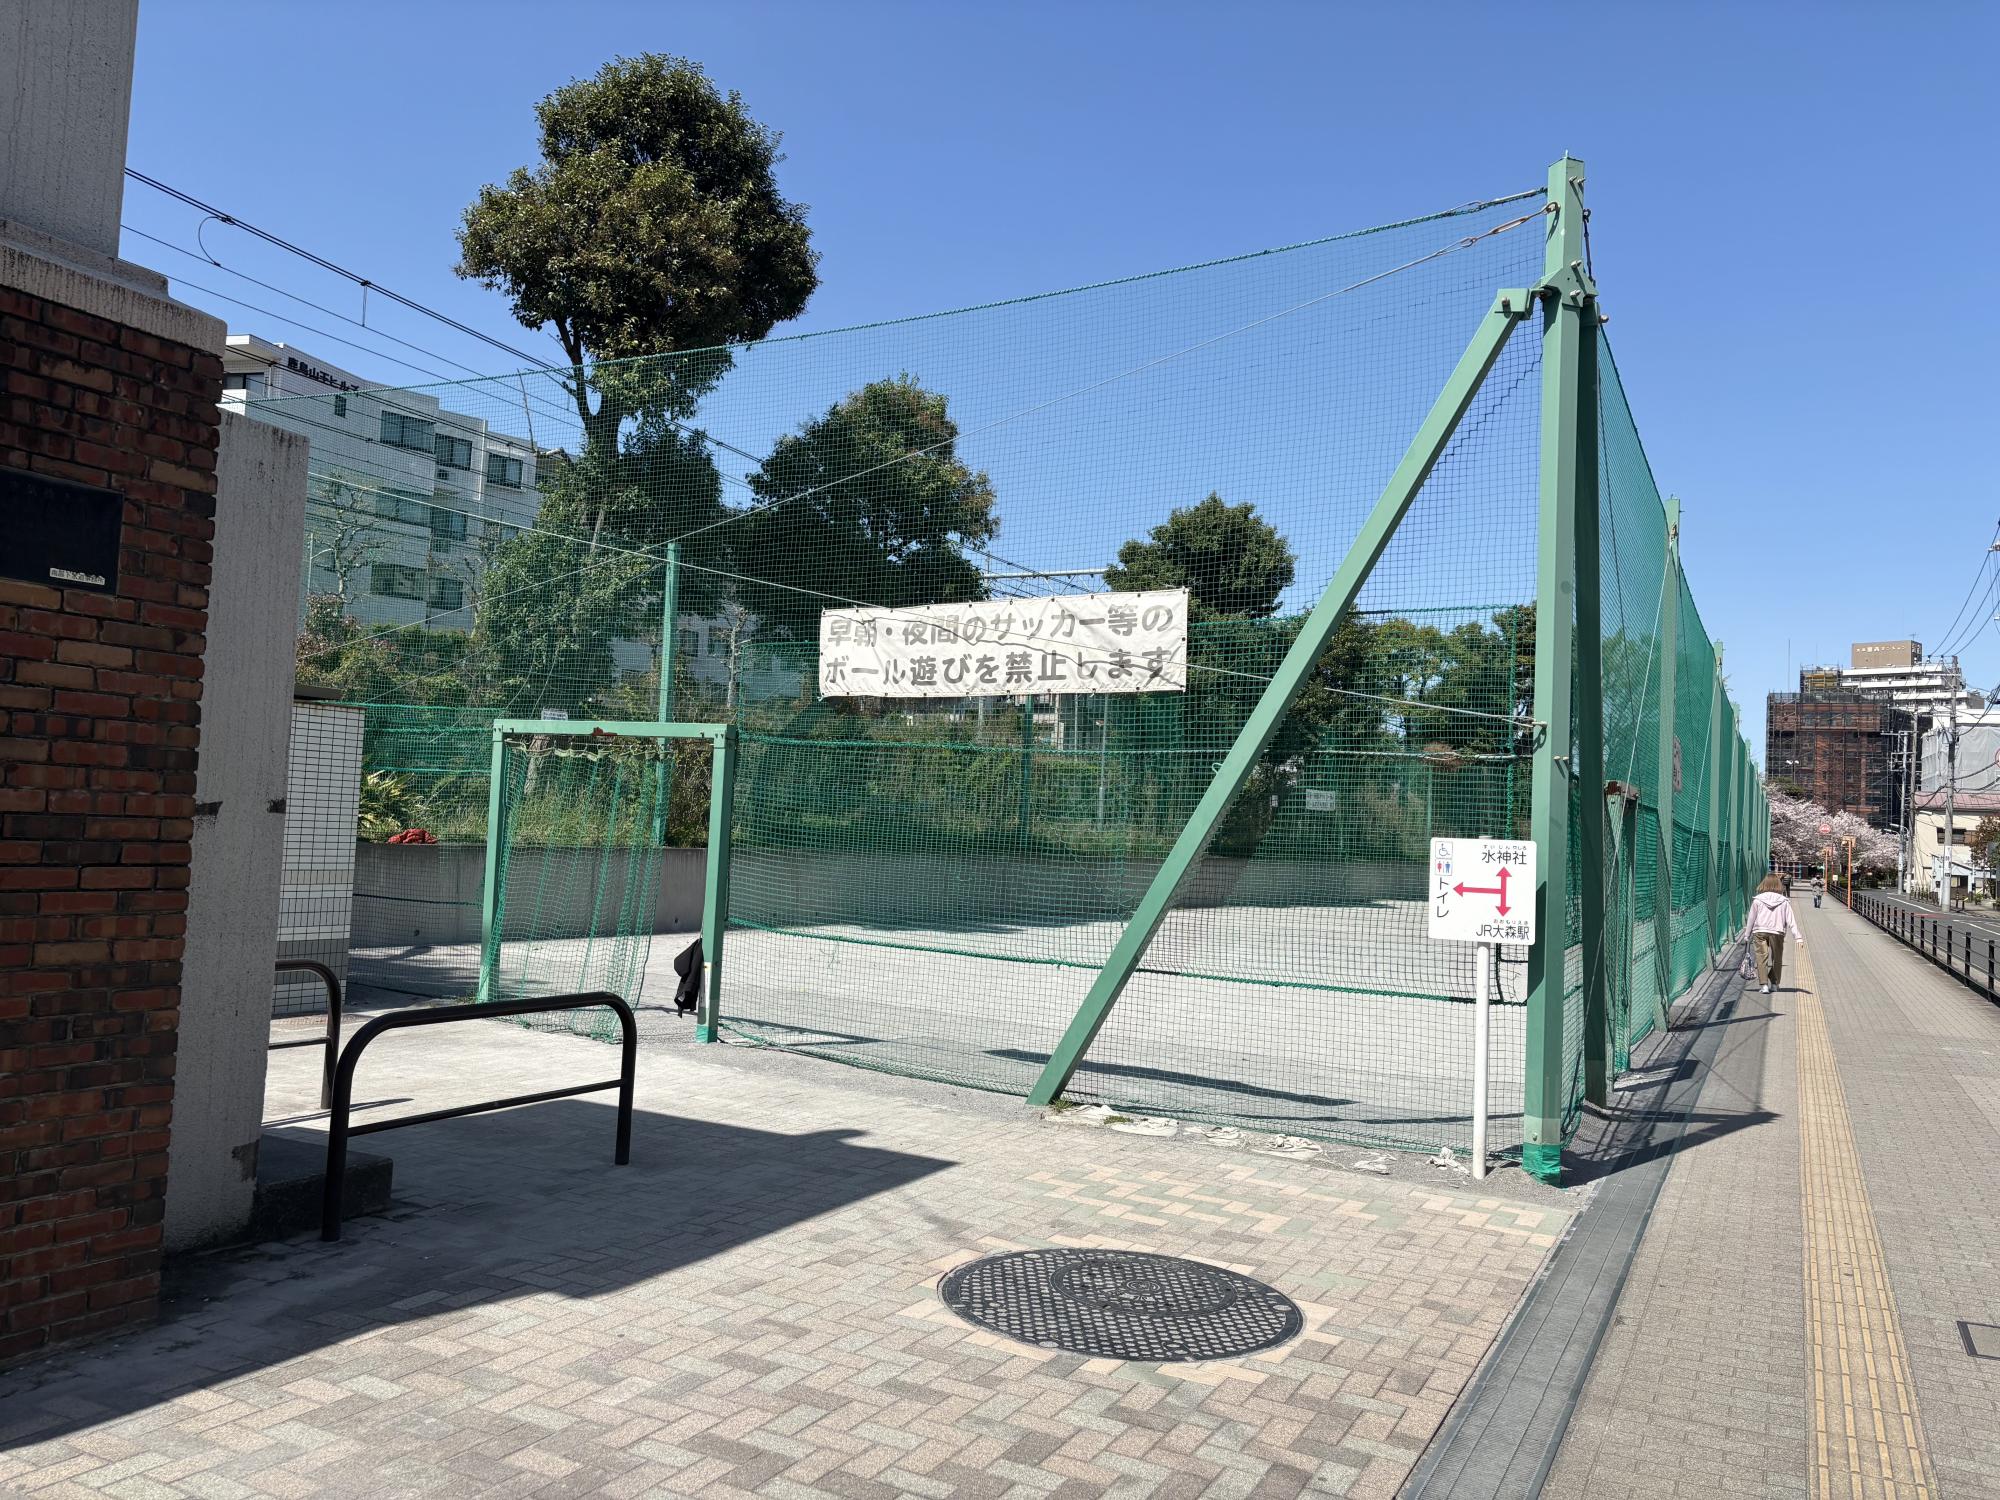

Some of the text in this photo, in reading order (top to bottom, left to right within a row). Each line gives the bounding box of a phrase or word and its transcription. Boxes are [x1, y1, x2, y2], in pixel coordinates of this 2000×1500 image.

[828, 604, 1173, 647] 早朝・夜間のサッカー等の
[826, 646, 1172, 687] ボール遊びを禁止します
[1482, 850, 1527, 865] 水神社
[1437, 877, 1449, 918] トイレ
[1476, 925, 1530, 940] JR大森駅
